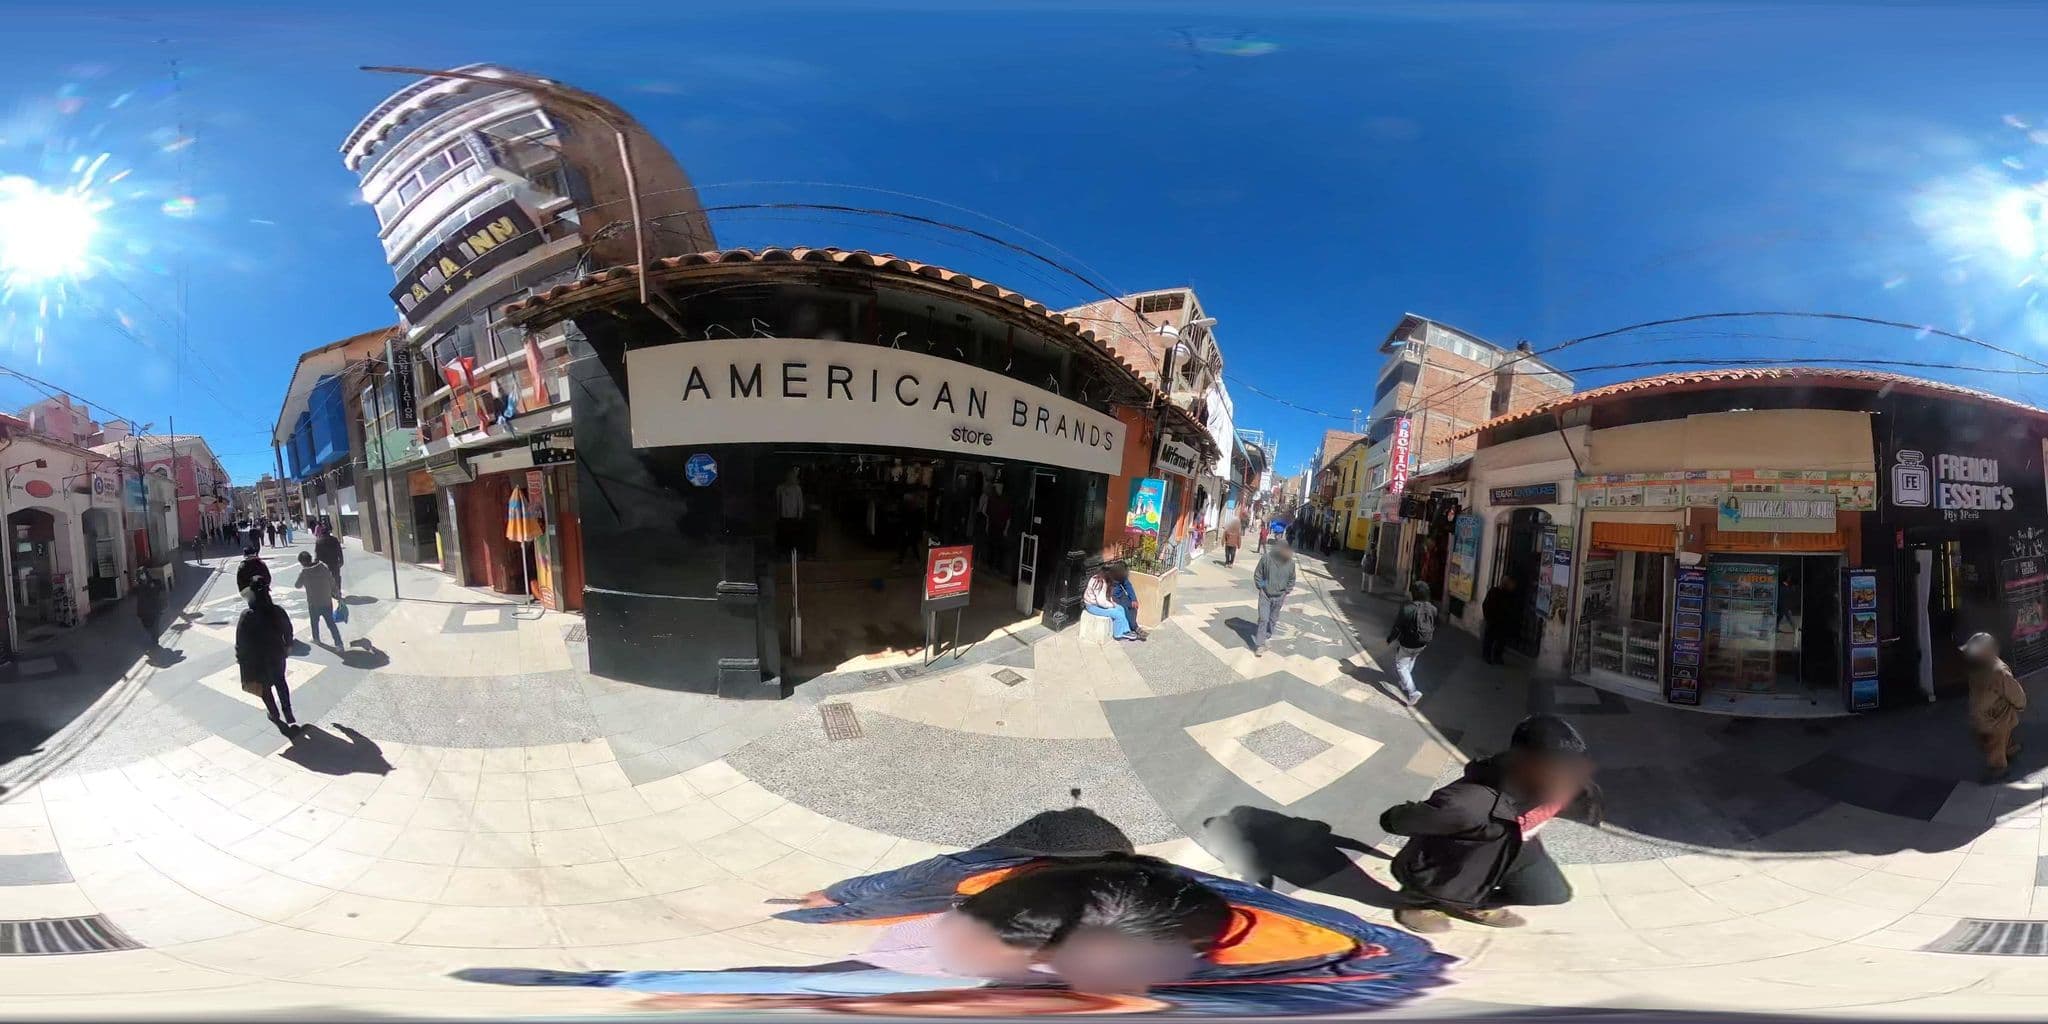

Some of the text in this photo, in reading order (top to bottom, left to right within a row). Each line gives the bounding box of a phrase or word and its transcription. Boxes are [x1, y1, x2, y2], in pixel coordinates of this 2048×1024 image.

[458, 216, 521, 261] INN
[681, 362, 1114, 451] AMERICAN BRANDS
[951, 425, 993, 446] store
[1393, 429, 1409, 490] BOTICAS
[1938, 453, 1998, 483] FRENCH
[1905, 475, 1918, 489] FE
[932, 556, 968, 584] 50
